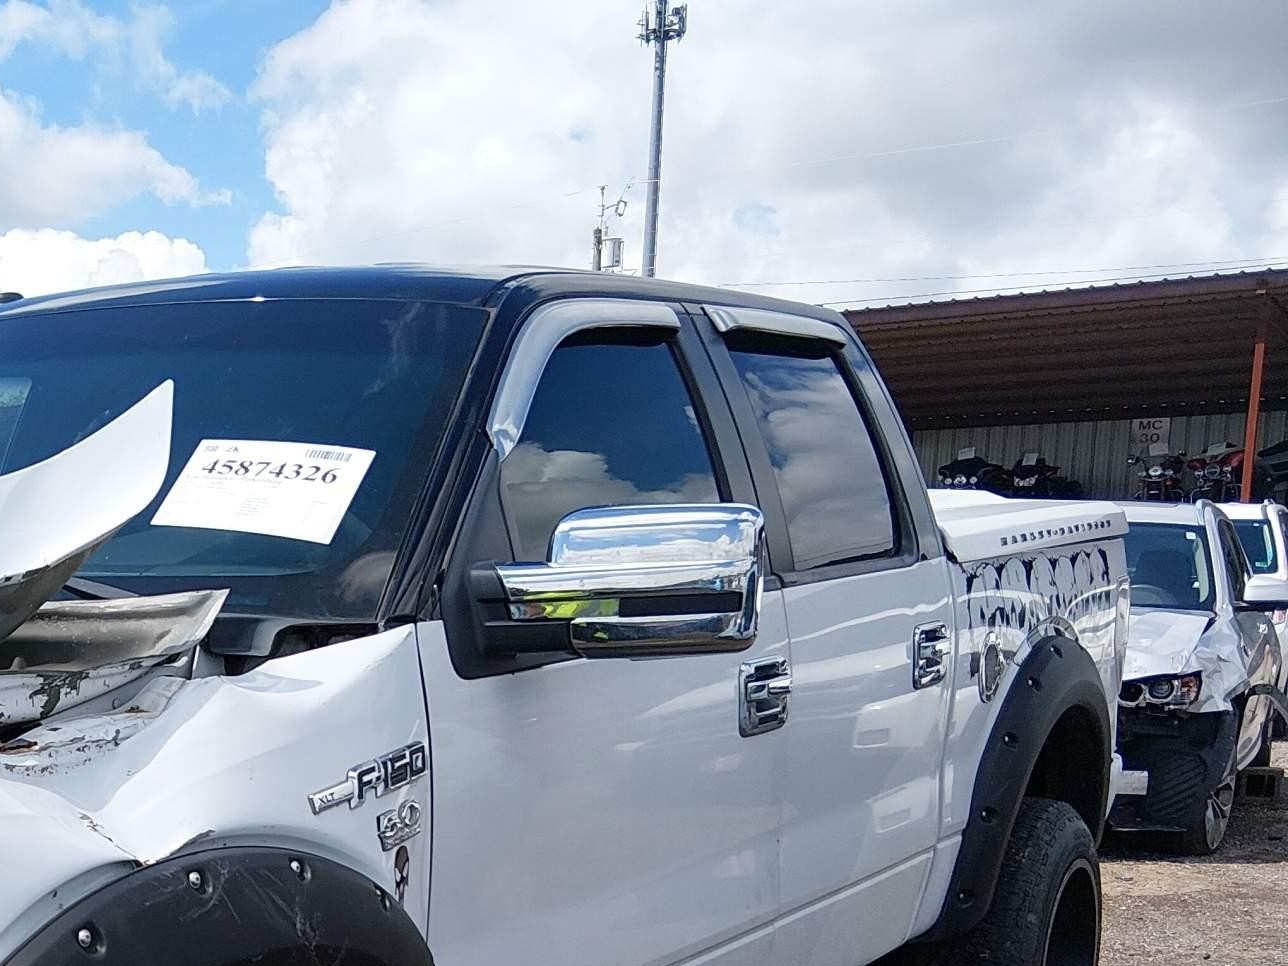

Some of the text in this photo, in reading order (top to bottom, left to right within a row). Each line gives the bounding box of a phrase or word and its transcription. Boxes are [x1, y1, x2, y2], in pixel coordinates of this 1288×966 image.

[1138, 420, 1163, 431] MC
[1139, 433, 1160, 443] 30
[202, 458, 340, 484] 45874326
[318, 793, 336, 806] XLT
